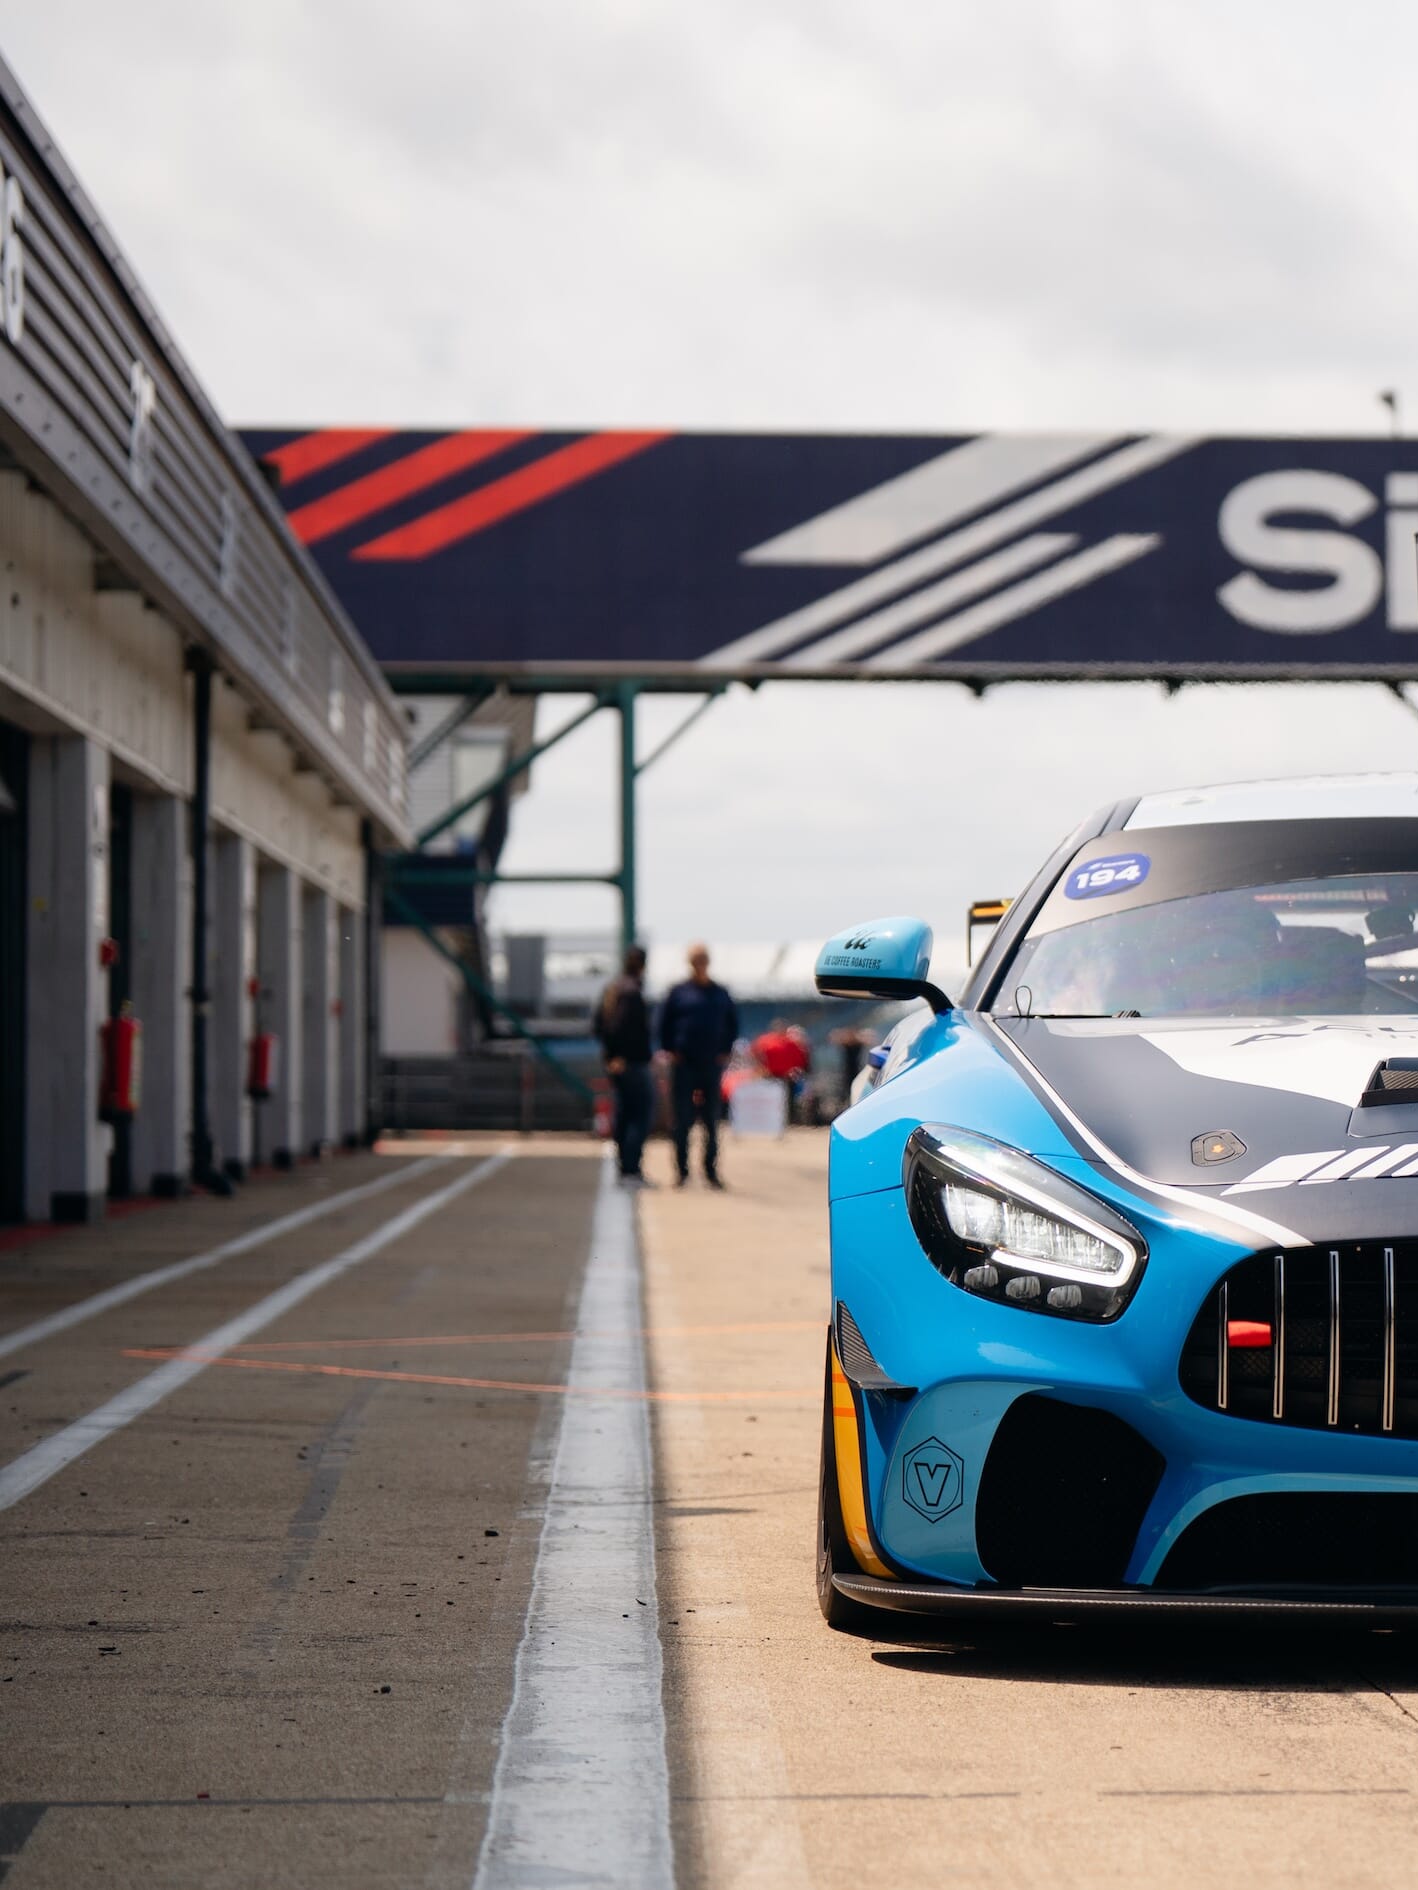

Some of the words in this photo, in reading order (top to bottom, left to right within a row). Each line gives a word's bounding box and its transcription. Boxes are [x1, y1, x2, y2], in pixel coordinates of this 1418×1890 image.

[1075, 864, 1142, 889] 194
[831, 955, 850, 967] COFFEE
[850, 957, 882, 970] ROASTERS
